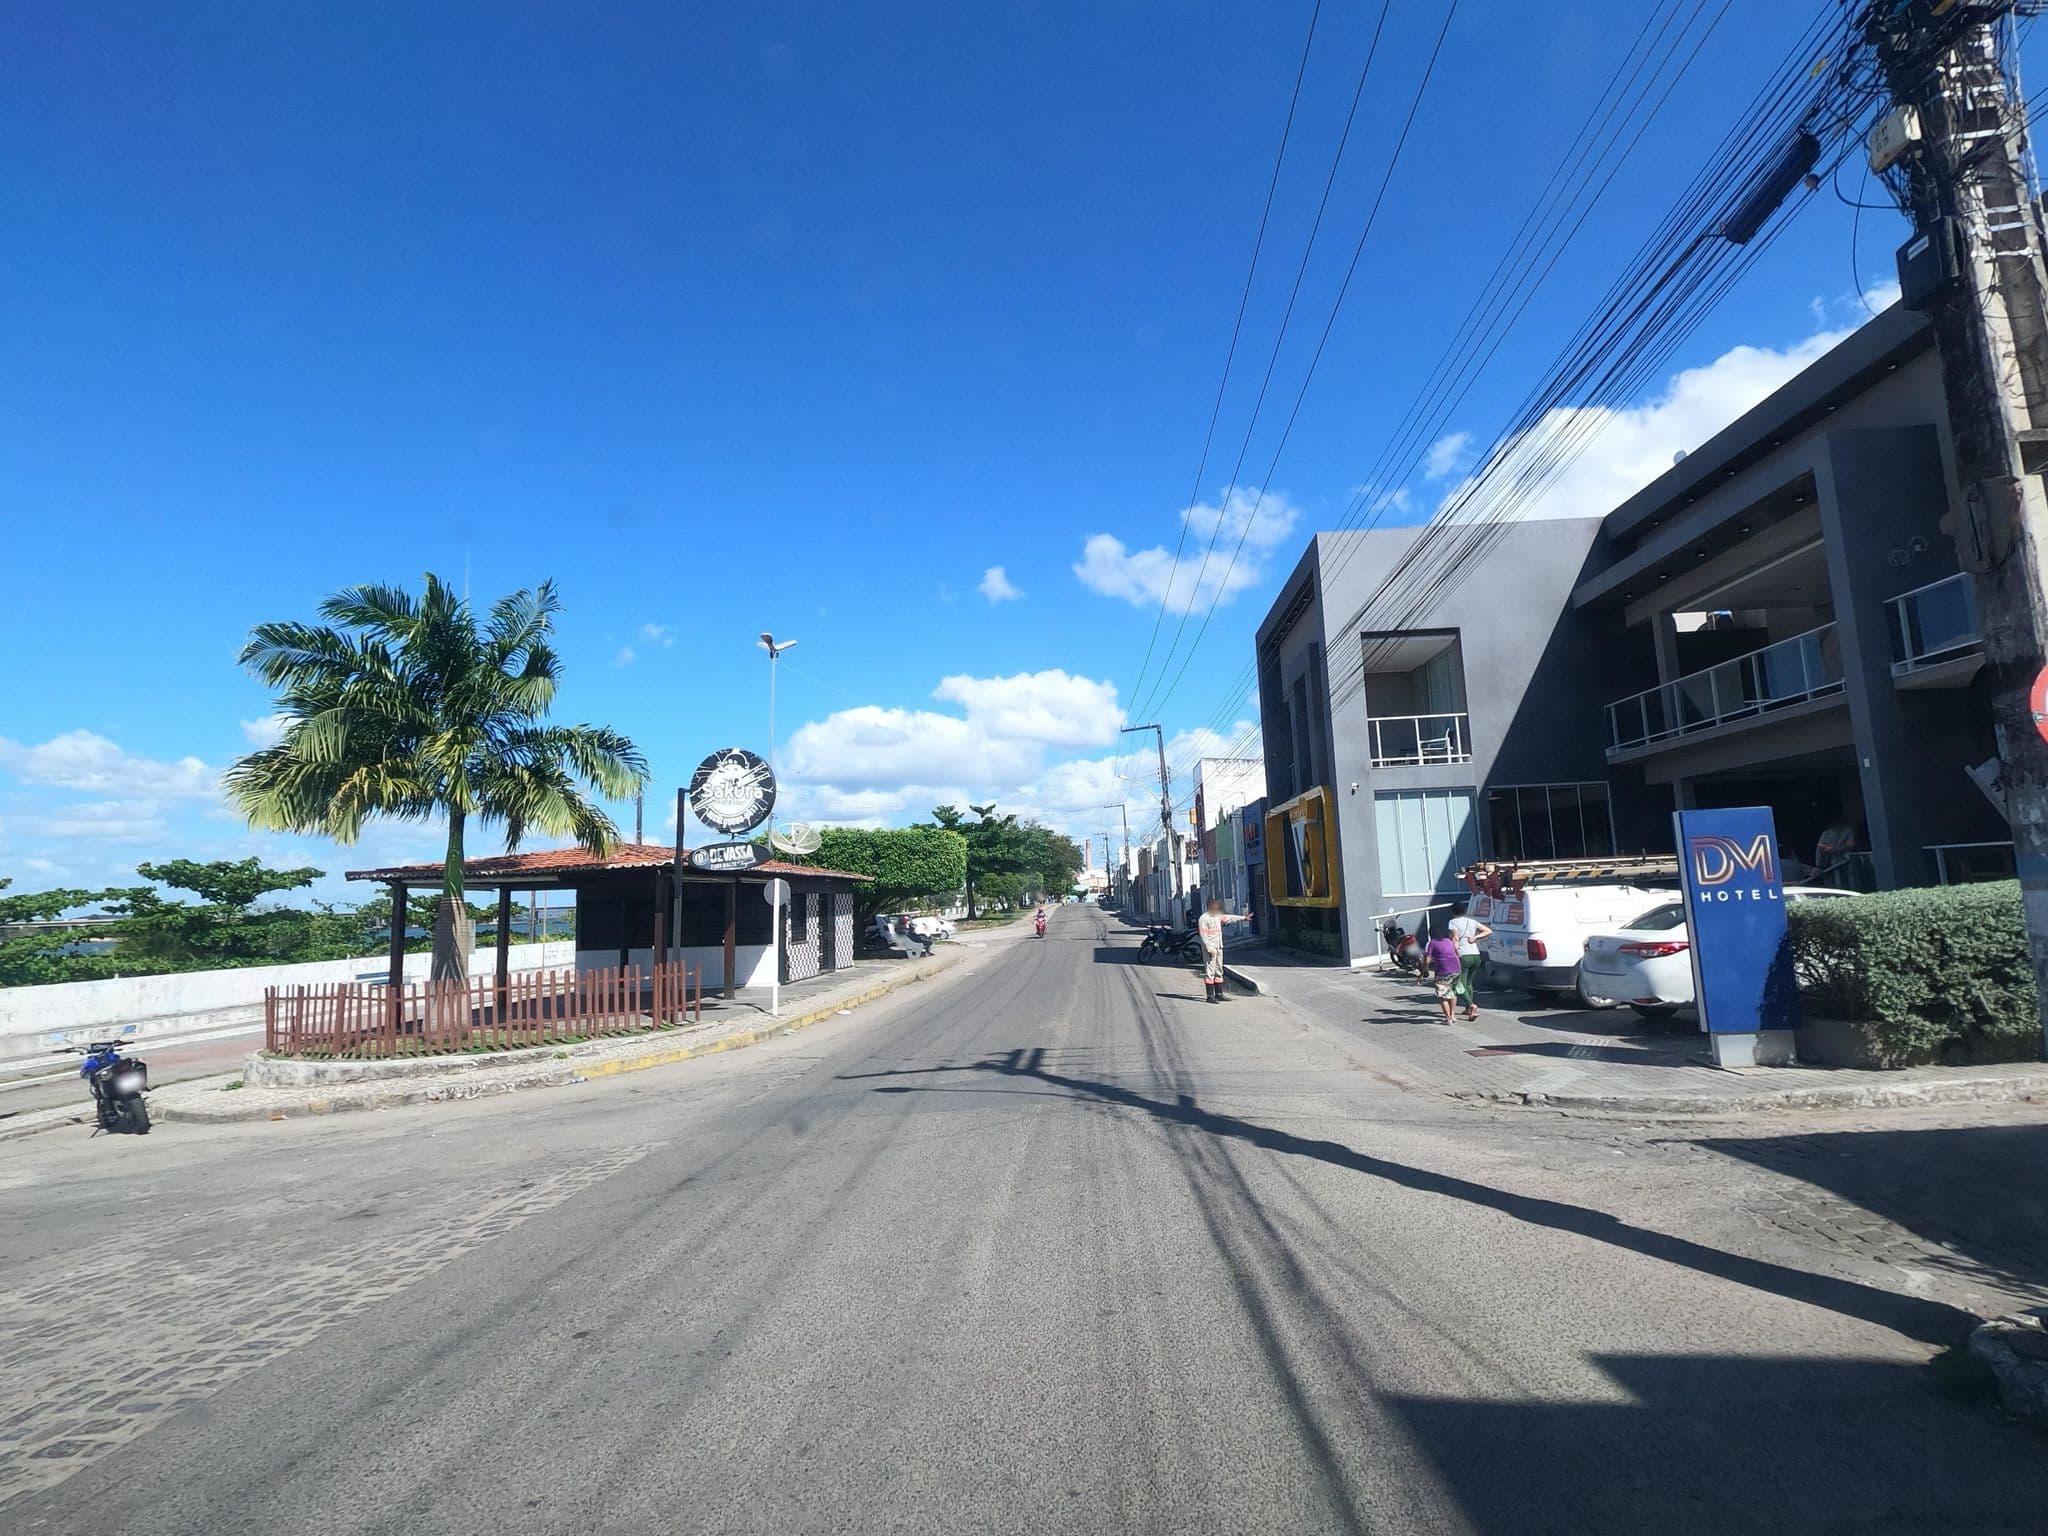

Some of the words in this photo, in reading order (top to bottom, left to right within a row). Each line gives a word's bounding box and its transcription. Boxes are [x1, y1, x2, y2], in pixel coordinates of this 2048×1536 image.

[701, 781, 764, 800] Sakura
[709, 845, 755, 863] DEVASSA
[1689, 834, 1774, 885] DM
[1700, 889, 1778, 902] HOTEL
